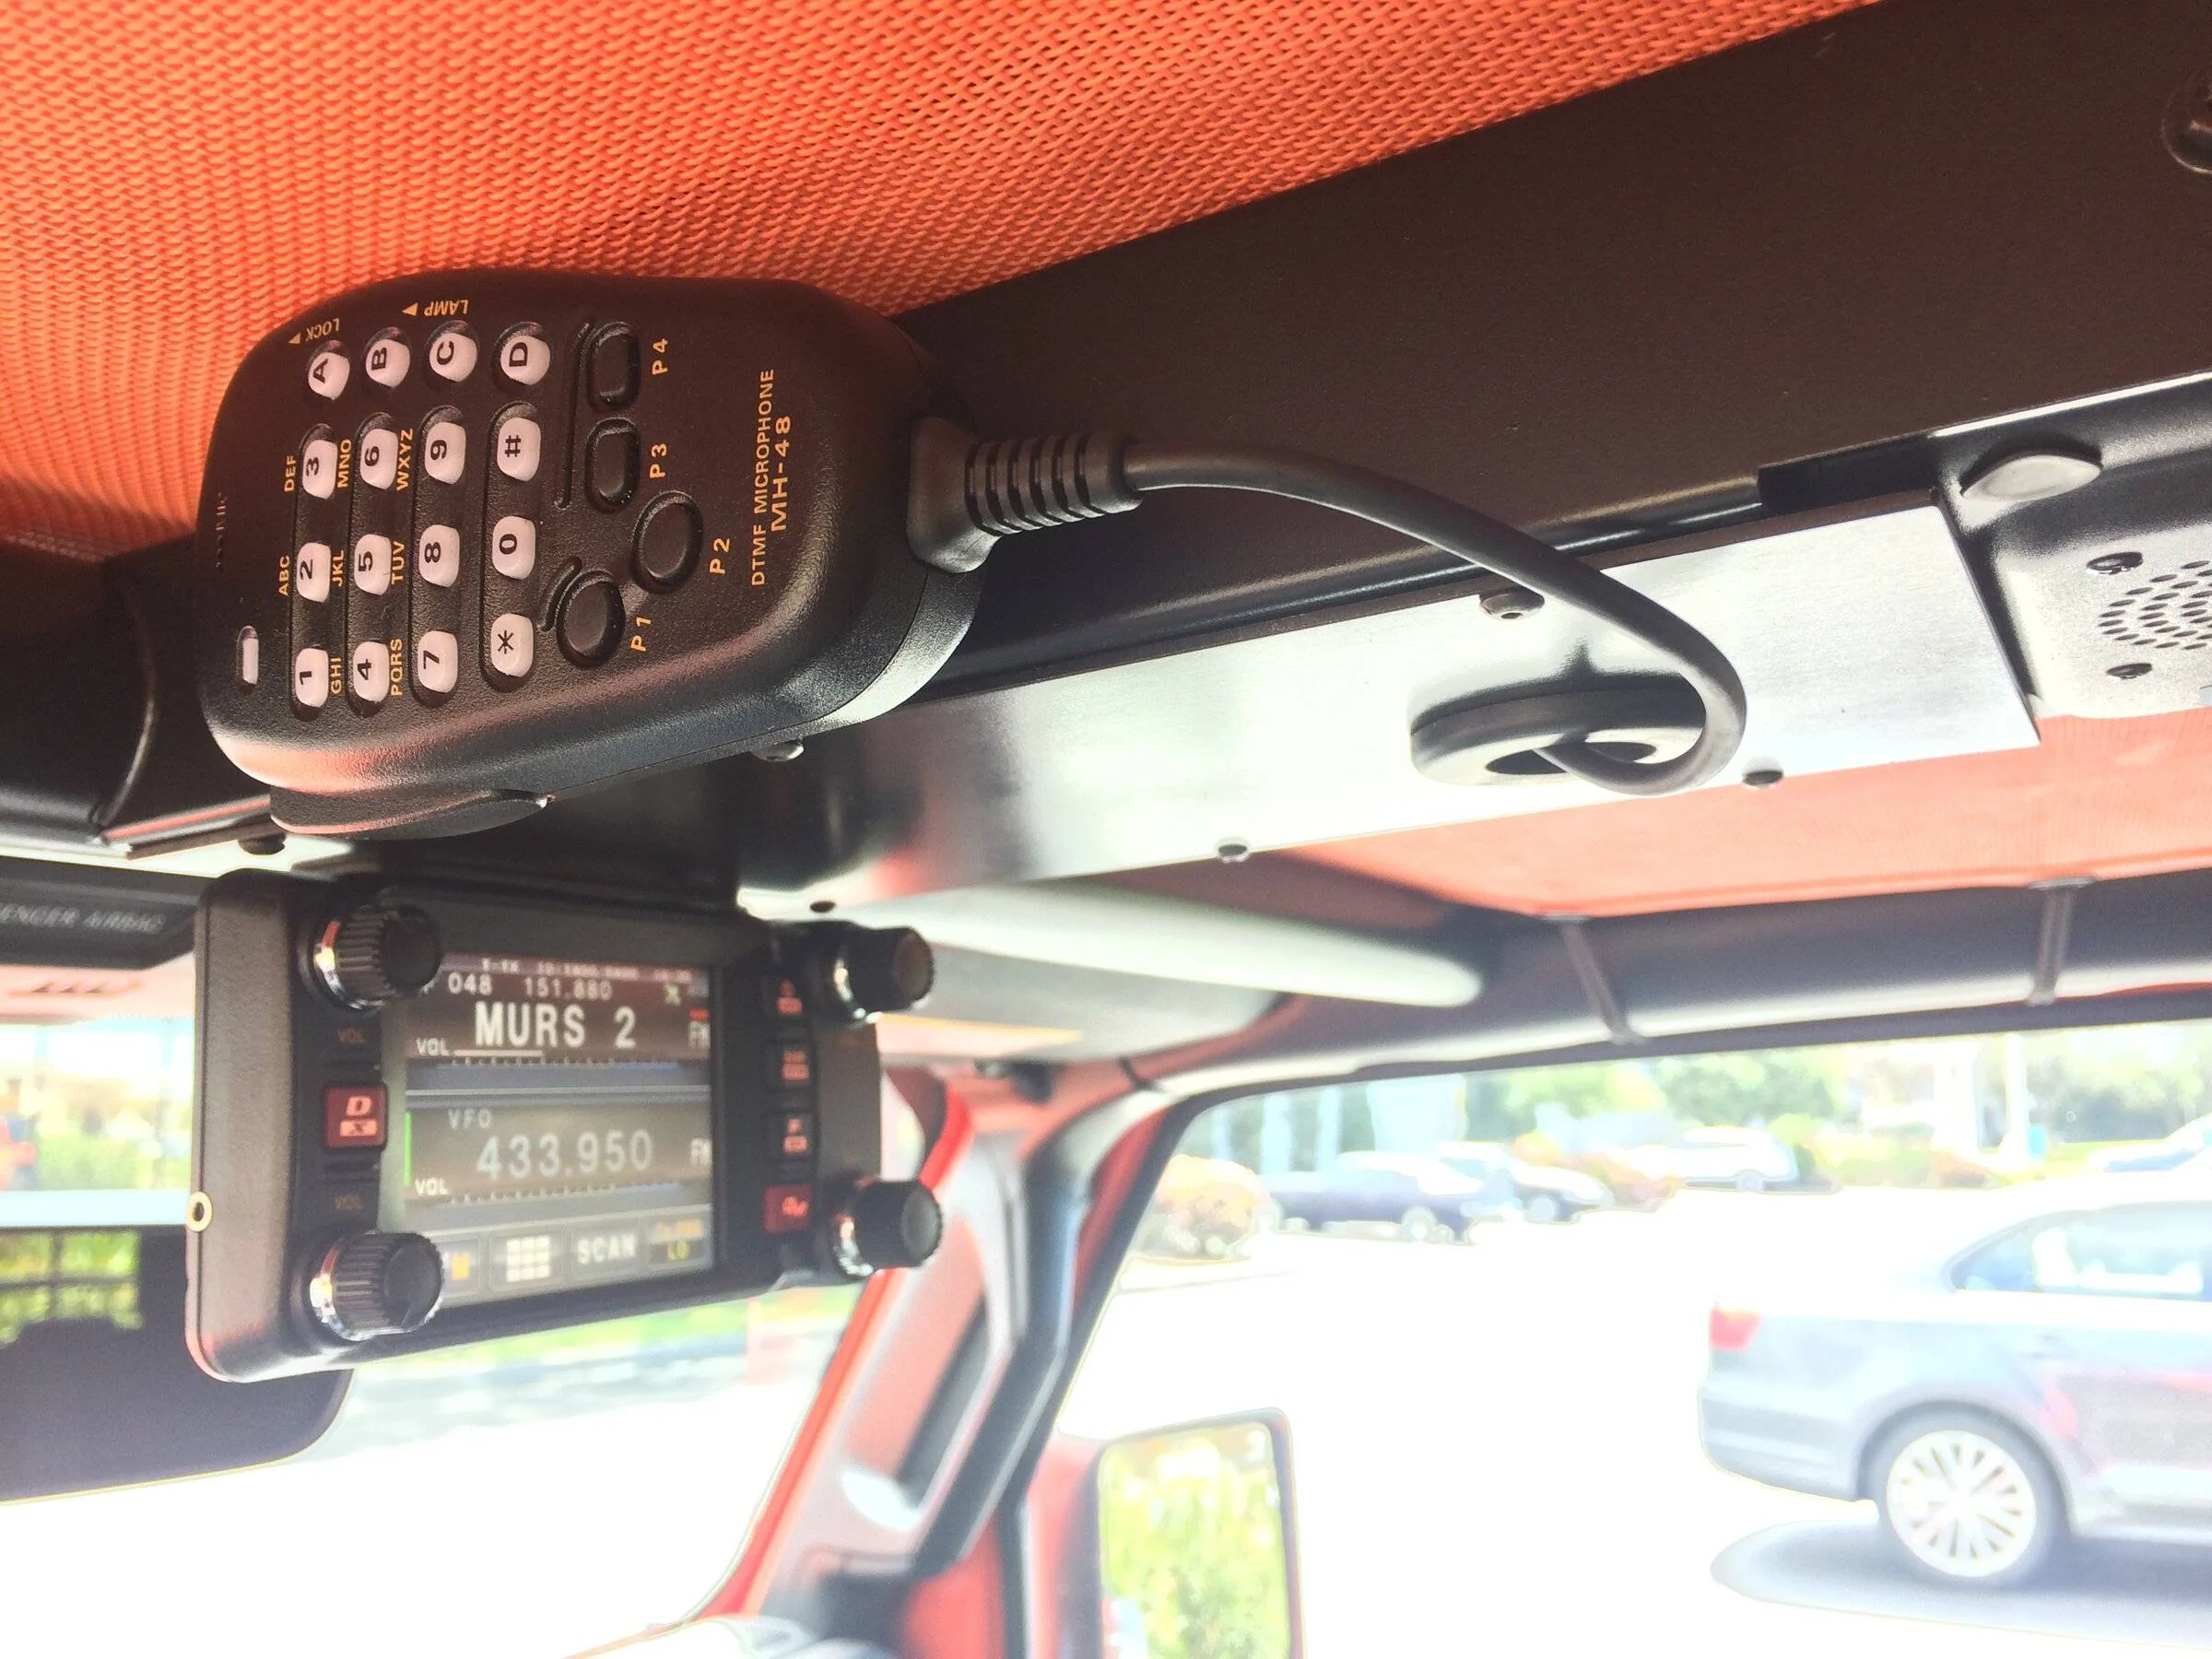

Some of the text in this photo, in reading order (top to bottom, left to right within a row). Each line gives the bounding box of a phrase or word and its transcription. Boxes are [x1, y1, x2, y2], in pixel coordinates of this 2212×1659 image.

[424, 299, 469, 316] LAMP
[304, 317, 340, 342] LOCK
[371, 346, 388, 371] B
[436, 340, 455, 365] C
[509, 341, 527, 368] D
[312, 358, 328, 384] A
[364, 445, 380, 466] 6
[396, 428, 414, 490] WXYZ
[430, 439, 448, 460] 9
[284, 455, 295, 491] DEF
[306, 456, 319, 477] 3
[336, 439, 352, 488] MNO
[771, 417, 791, 532] MH-48
[751, 369, 774, 586] DTMF MICROPHONE
[359, 550, 373, 571] 5
[392, 541, 405, 583] TUV
[424, 541, 441, 563] 8
[278, 554, 290, 596] ABC
[300, 559, 313, 580] 2
[332, 550, 344, 586] JKL
[357, 659, 371, 681] 4
[391, 638, 403, 696] PQRS
[423, 650, 441, 669] 7
[299, 671, 312, 685] 1
[331, 657, 342, 694] GHI
[448, 972, 613, 1001] 048 151.880
[475, 1001, 637, 1050] MURS 2
[416, 1038, 450, 1056] VOL
[448, 1109, 493, 1130] VFO
[476, 1129, 653, 1180] 433.950
[415, 1178, 449, 1196] VOL
[577, 1234, 637, 1265] SCAN
